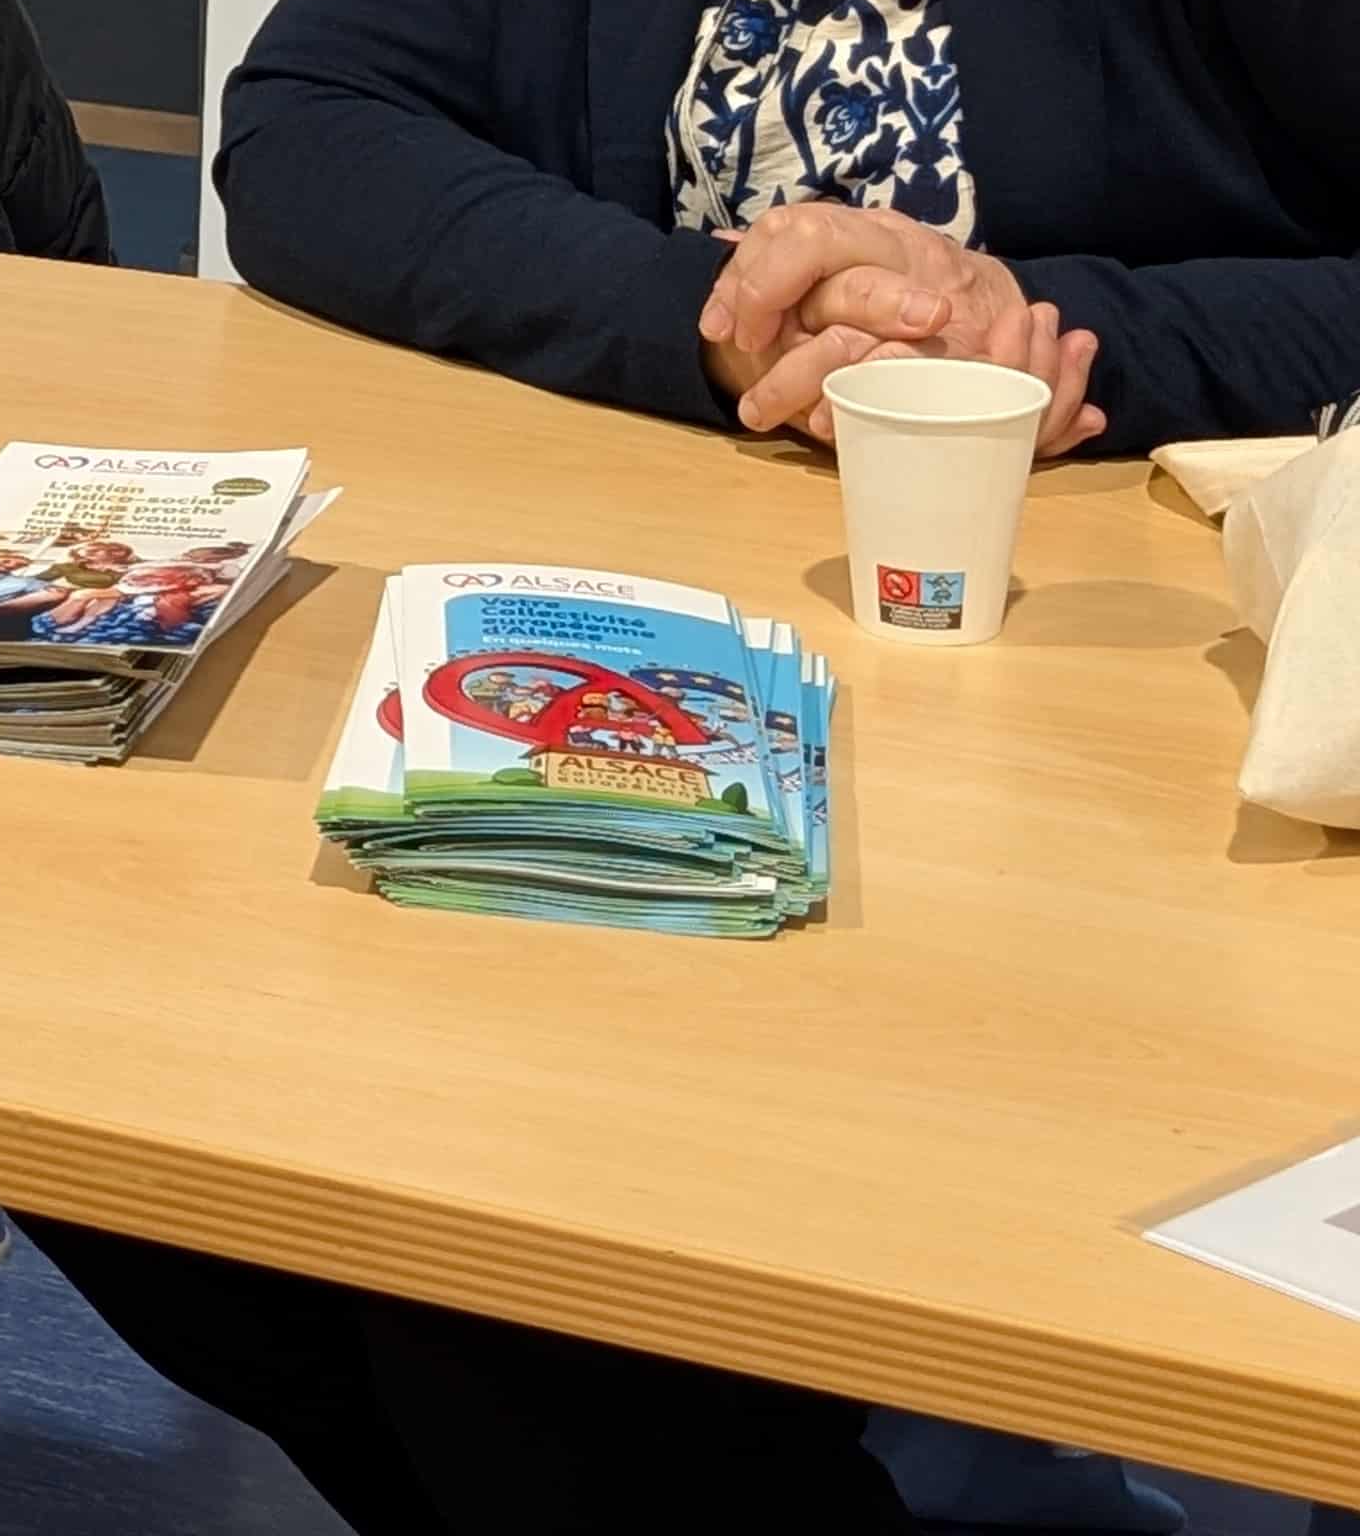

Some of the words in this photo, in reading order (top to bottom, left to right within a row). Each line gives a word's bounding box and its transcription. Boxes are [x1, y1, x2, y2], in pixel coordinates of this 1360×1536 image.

[92, 458, 209, 473] ALSACE
[131, 514, 192, 524] vous
[132, 505, 222, 517] proche
[509, 575, 635, 596] ALSACE
[481, 596, 560, 609] Votre
[481, 606, 646, 629] Collectivité
[481, 617, 656, 639] européenne
[558, 756, 698, 785] ALSACE
